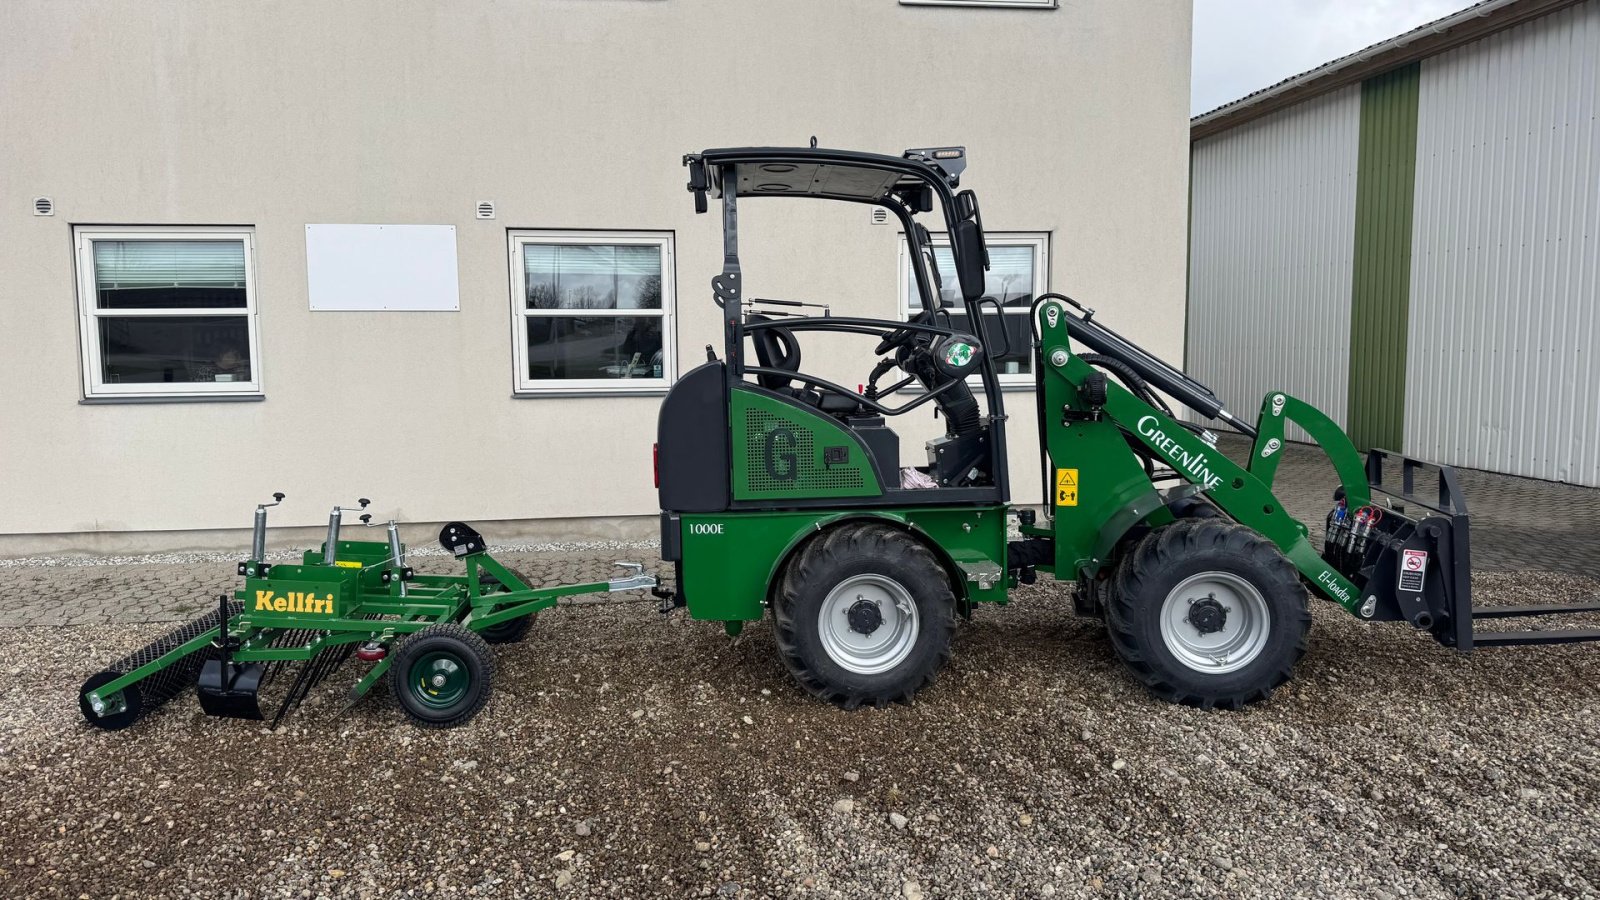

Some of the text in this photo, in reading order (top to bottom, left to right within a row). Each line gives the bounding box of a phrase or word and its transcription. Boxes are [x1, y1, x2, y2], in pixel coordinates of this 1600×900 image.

[764, 427, 797, 481] G
[689, 523, 725, 535] 1000E
[255, 590, 334, 614] Kellfri
